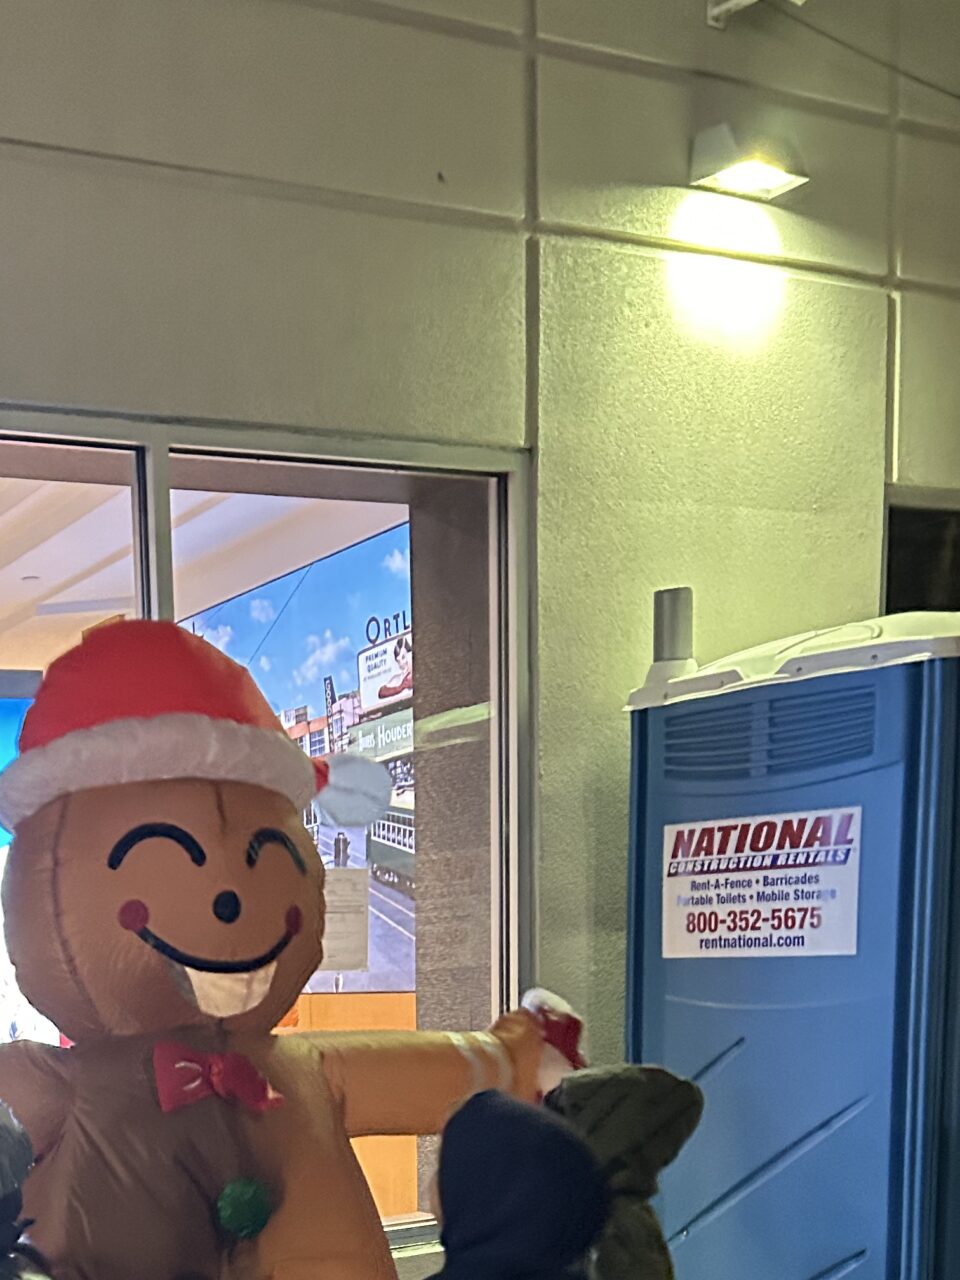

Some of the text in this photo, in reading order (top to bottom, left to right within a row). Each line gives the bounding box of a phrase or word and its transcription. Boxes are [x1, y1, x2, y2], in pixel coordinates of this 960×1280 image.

[367, 658, 388, 673] QUALITY
[671, 813, 855, 860] NATIONAL
[669, 848, 847, 874] CONSTRUCTION RENTALS
[690, 873, 820, 892] Rent-A-Fence Barricades
[716, 890, 747, 904] Toilets
[756, 889, 790, 903] Mobile
[686, 907, 822, 934] 800-352-5675
[699, 933, 805, 950] rentnational.com
